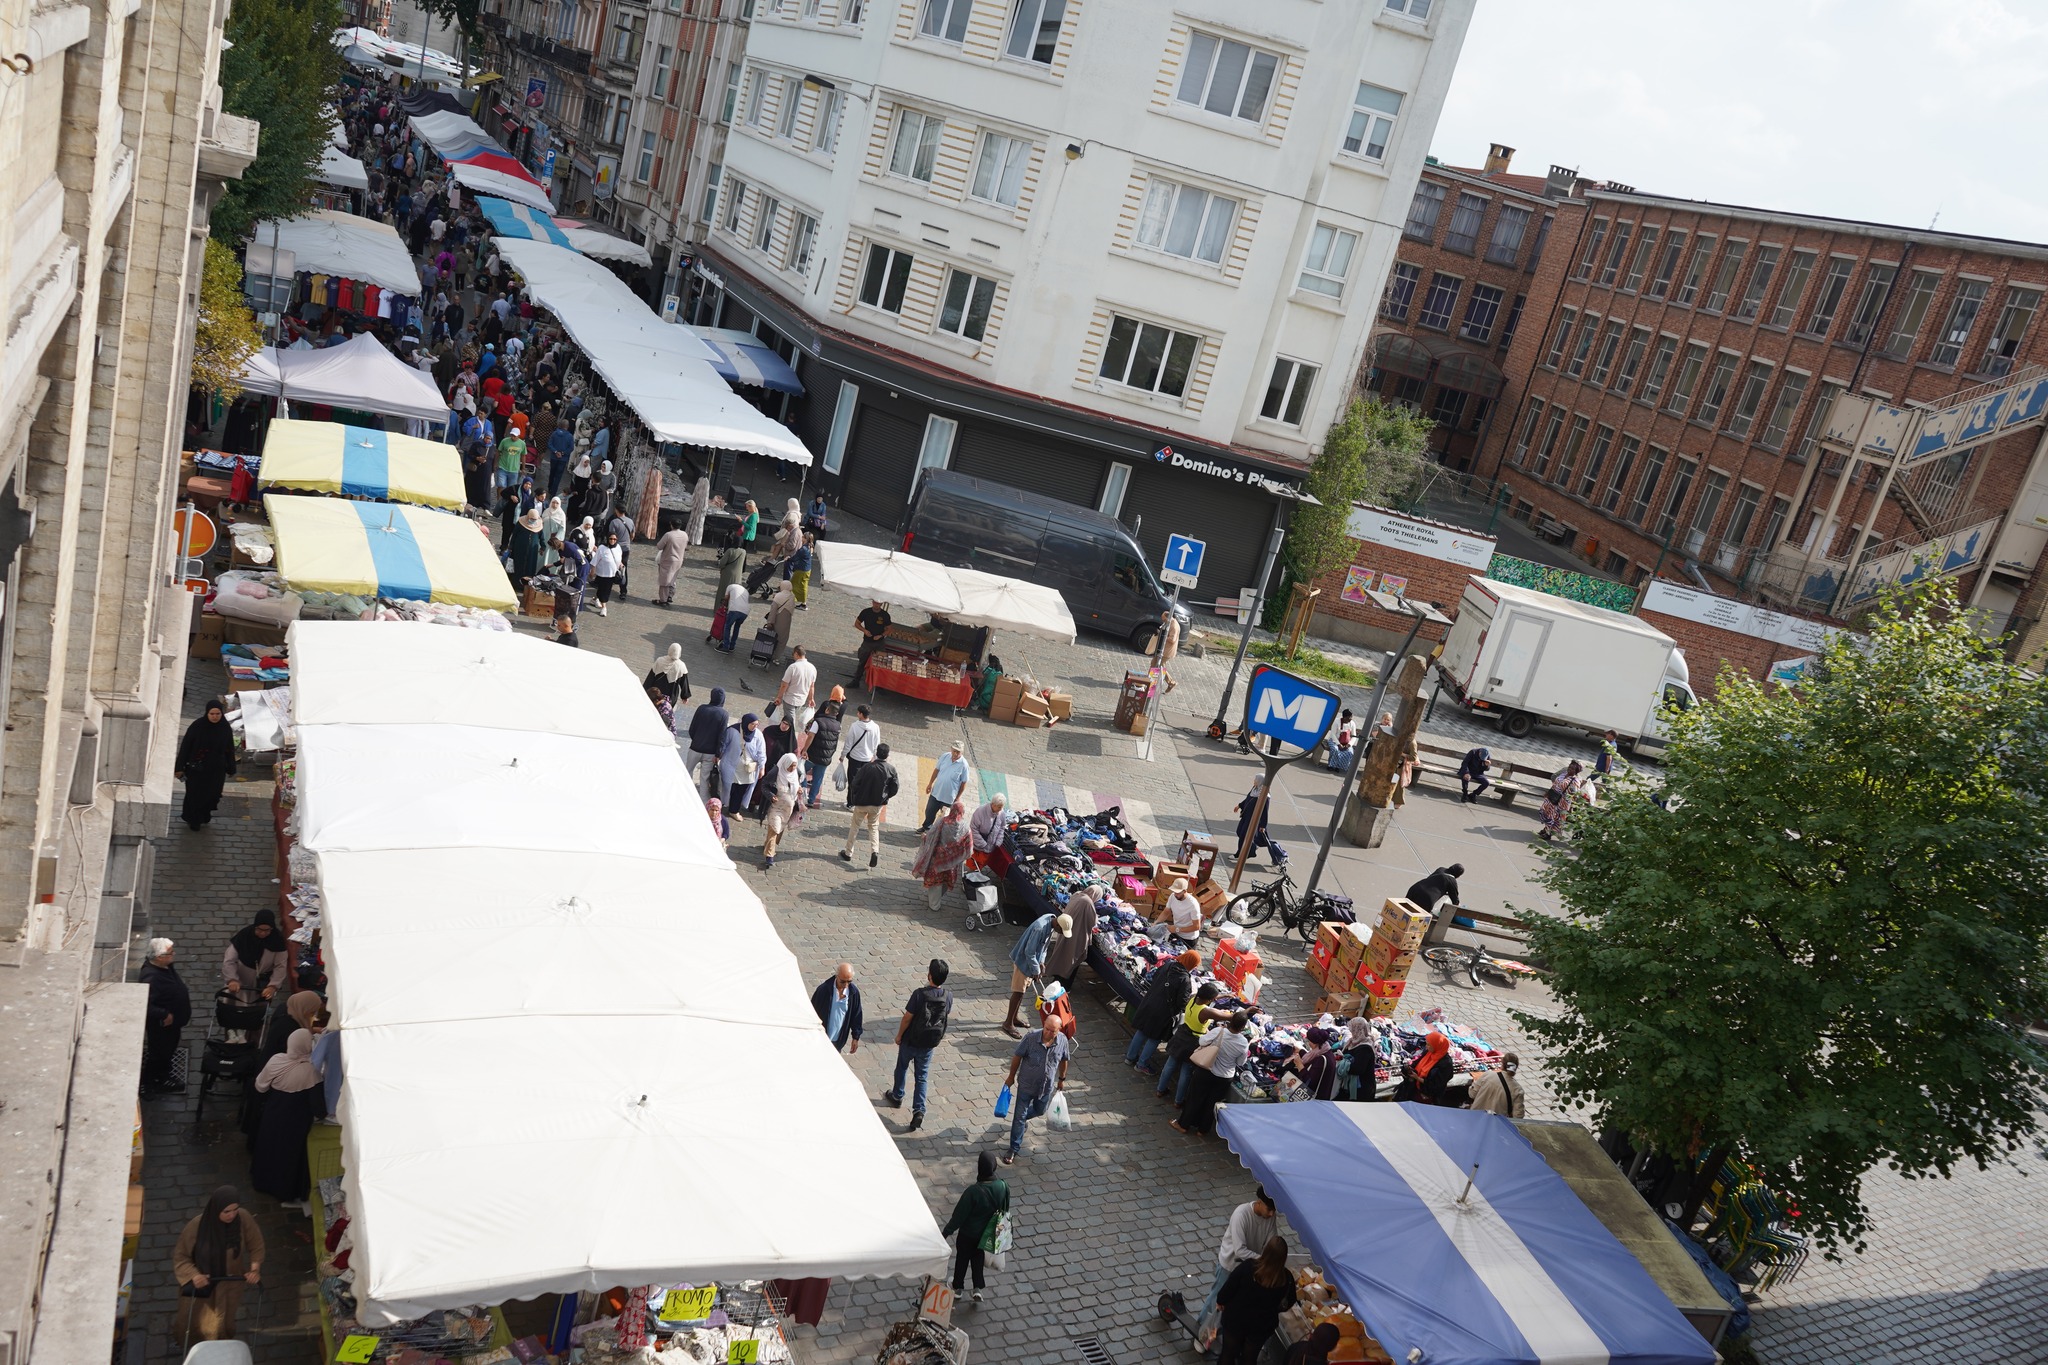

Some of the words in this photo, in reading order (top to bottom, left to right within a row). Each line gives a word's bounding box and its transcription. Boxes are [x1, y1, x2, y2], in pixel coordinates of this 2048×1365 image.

[546, 150, 555, 161] P
[1171, 452, 1245, 483] Domino's
[1380, 526, 1400, 535] TOOTS
[1401, 531, 1439, 545] THIELEMANS
[1387, 520, 1415, 530] ATHENEE
[1416, 526, 1435, 536] ROYAL
[1254, 687, 1328, 734] M
[664, 1289, 713, 1308] PROMO
